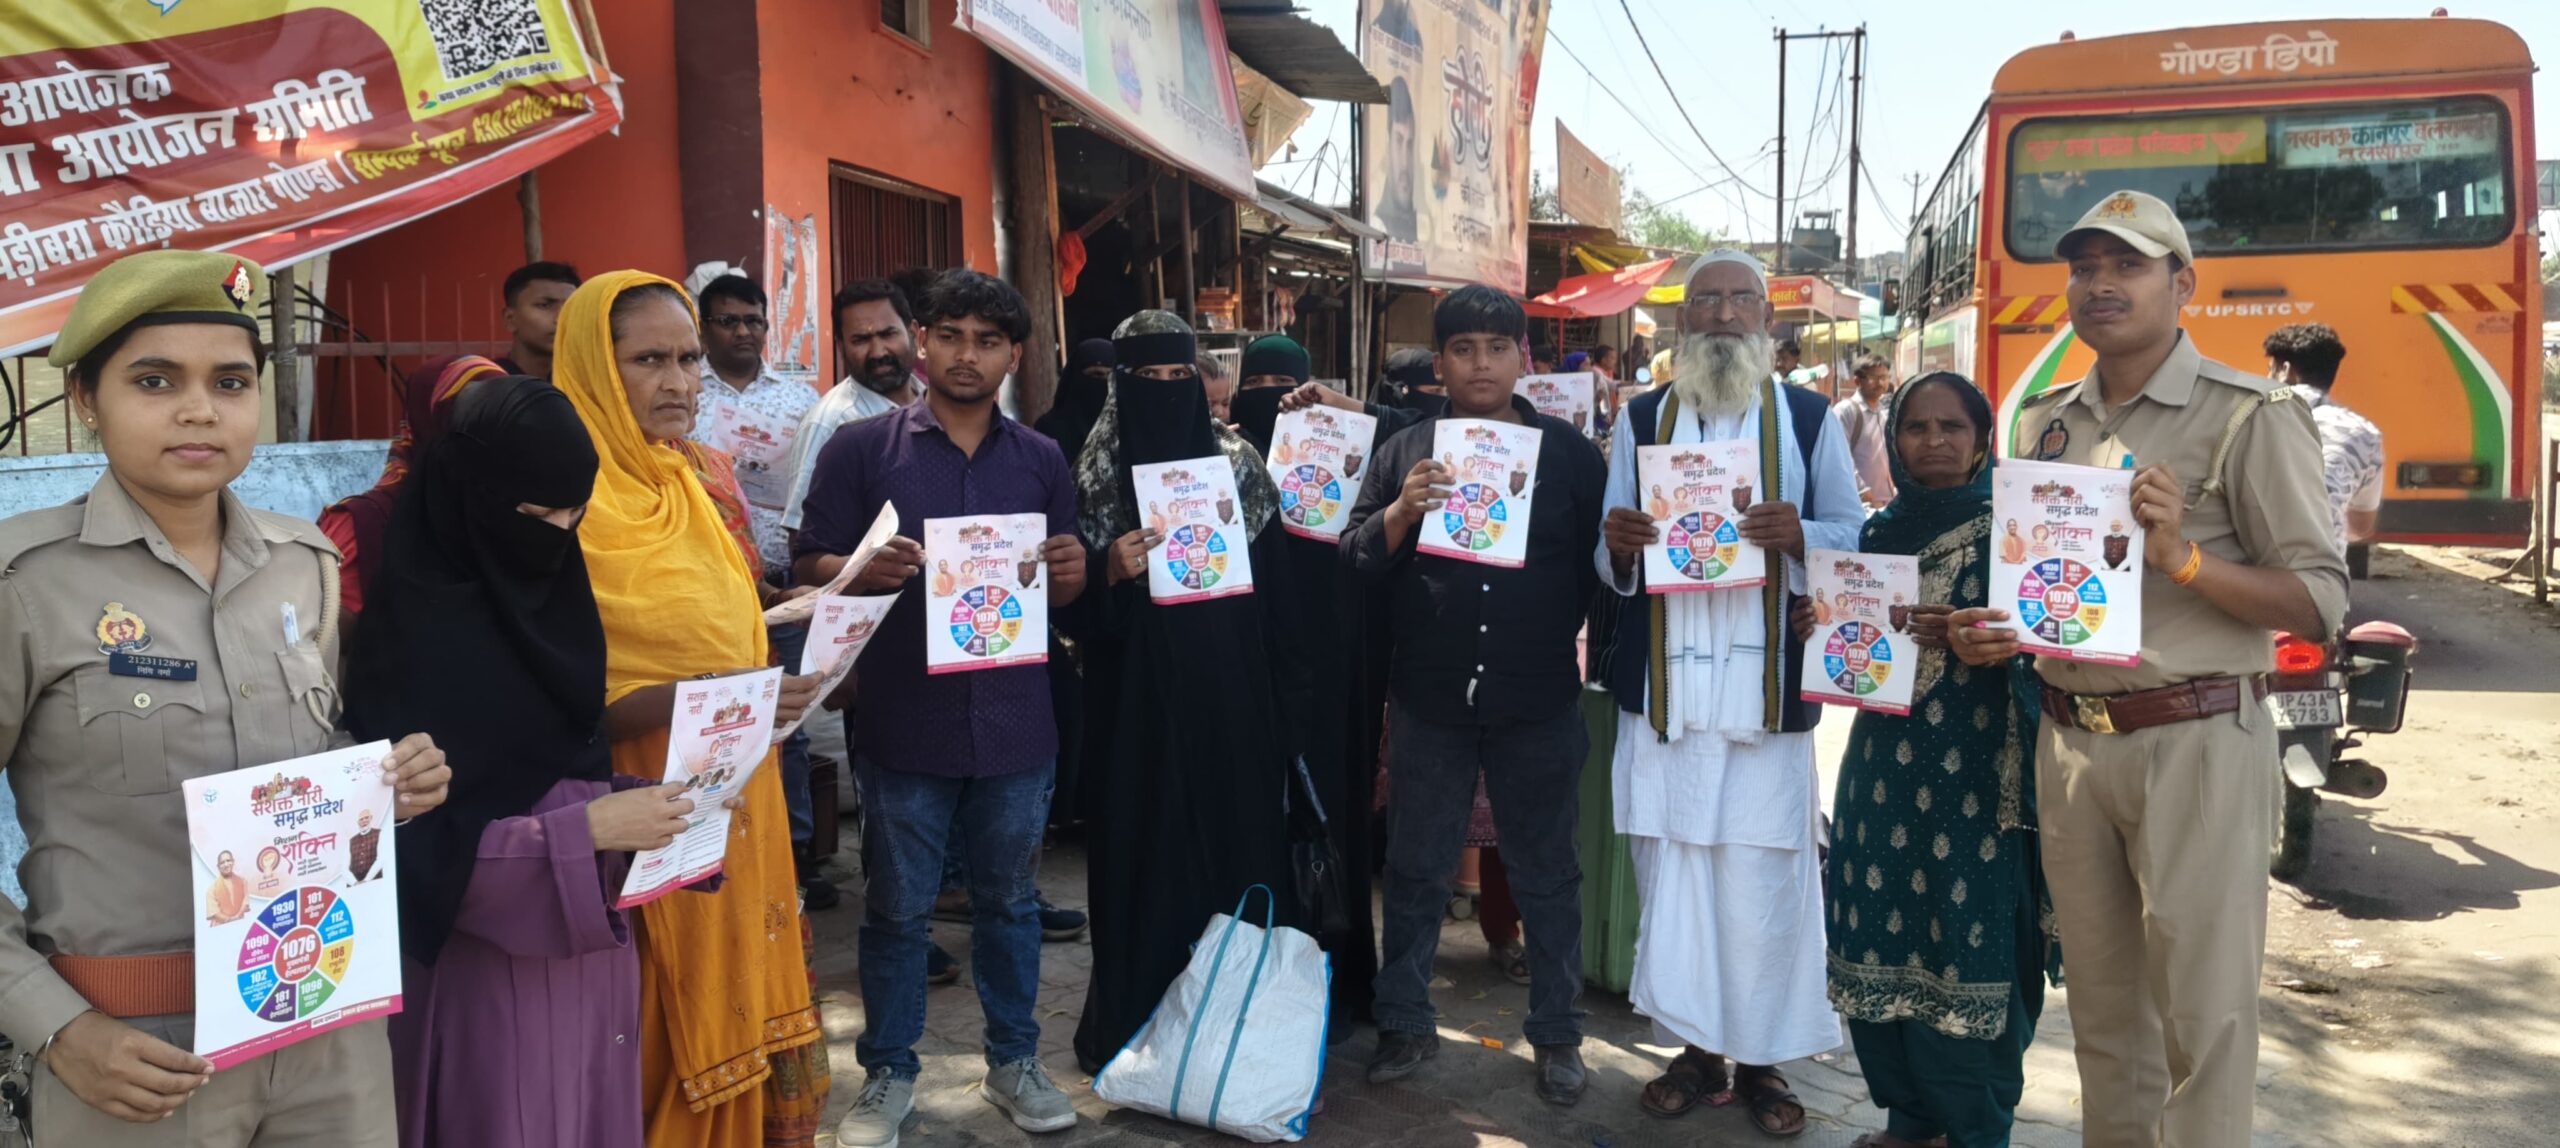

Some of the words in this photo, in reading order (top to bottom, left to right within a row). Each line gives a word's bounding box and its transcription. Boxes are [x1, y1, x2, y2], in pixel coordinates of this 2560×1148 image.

[2160, 42, 2258, 76] गोण्डा
[2262, 30, 2340, 72] डिपो
[0, 60, 172, 127] आयोजक
[52, 108, 239, 184] आयोजन
[244, 68, 374, 142] समिति
[2351, 122, 2413, 147] कानपुर
[90, 194, 205, 251] कौड़िया
[194, 177, 279, 223] बाजार
[263, 161, 345, 203] गोण्डा
[2205, 303, 2293, 317] UPSRTC
[2046, 505, 2072, 518] समृद्ध
[2075, 503, 2099, 516] प्रदेश
[2048, 590, 2075, 604] 1076
[128, 655, 181, 668] 212311286
[251, 797, 293, 817] सशक्त
[298, 784, 323, 804] नारी
[273, 808, 309, 830] समृद्ध
[313, 798, 344, 820] प्रदेश
[281, 831, 337, 875] शक्ति
[307, 891, 323, 905] 101
[271, 900, 295, 917] 1930
[331, 910, 344, 923] 112
[245, 934, 270, 951] 1090
[281, 934, 316, 961] 1076
[250, 969, 267, 983] 102
[301, 978, 323, 995] 1098
[274, 989, 290, 1003] 181
